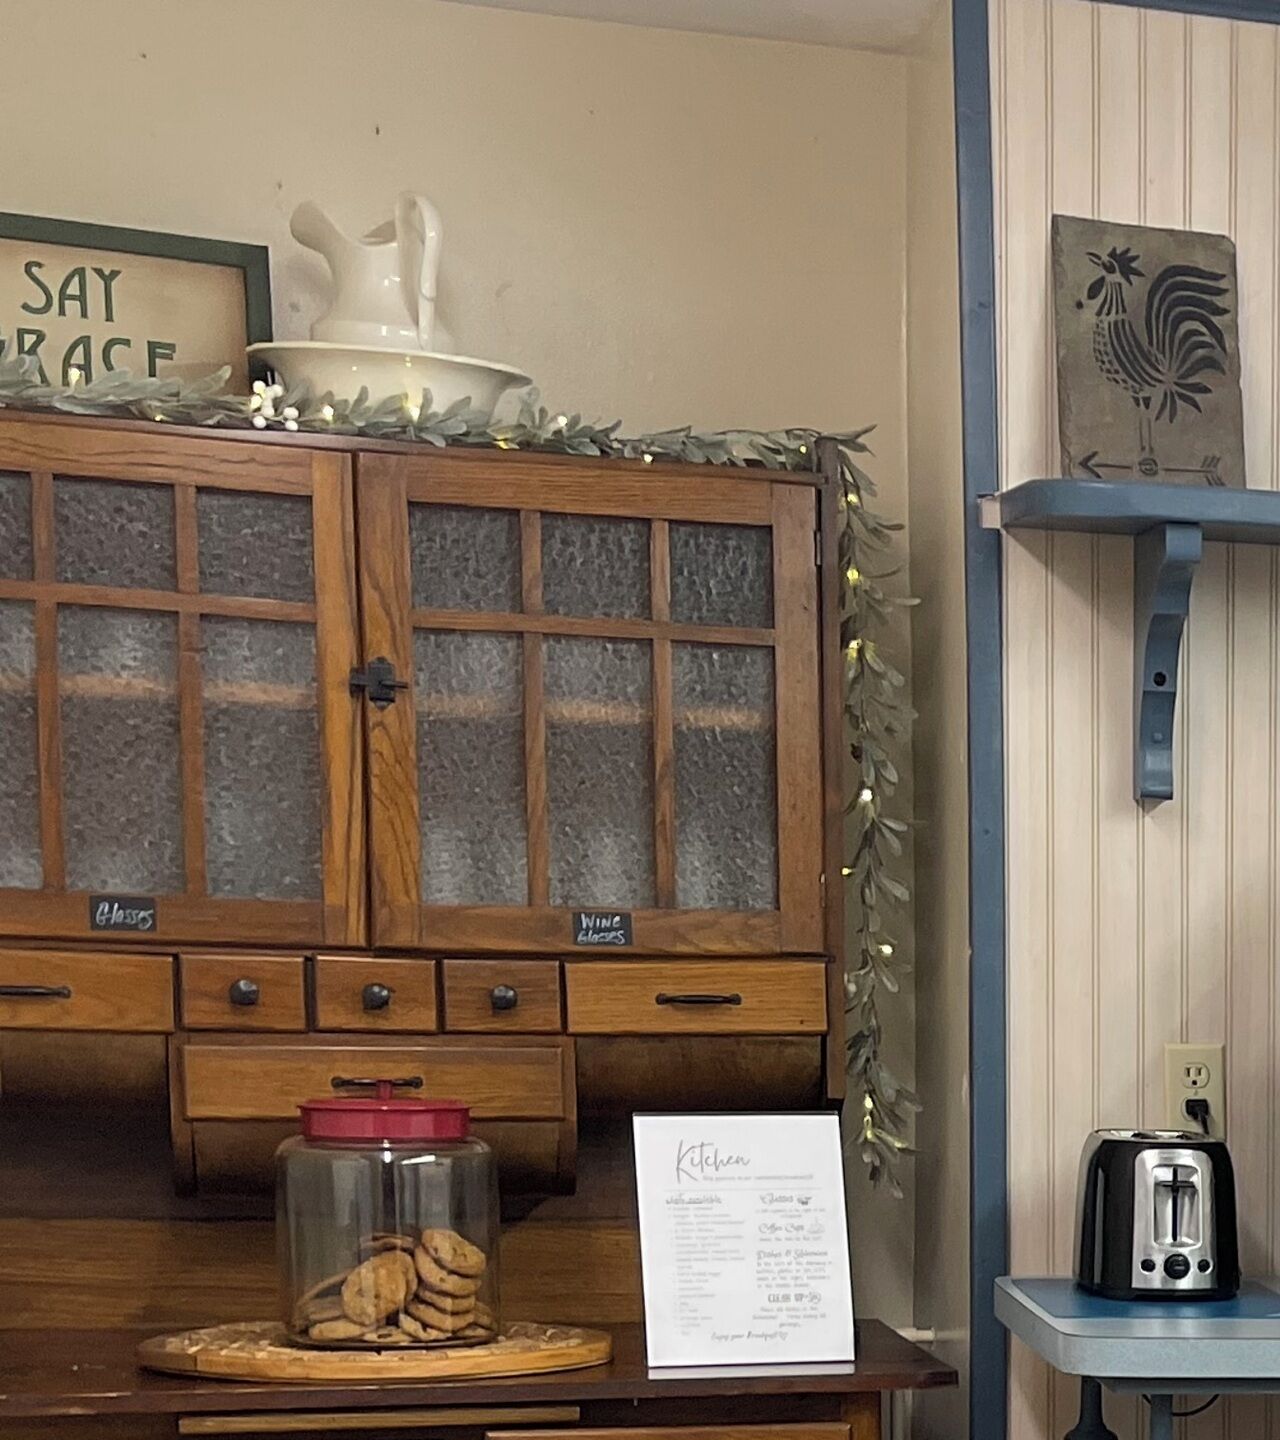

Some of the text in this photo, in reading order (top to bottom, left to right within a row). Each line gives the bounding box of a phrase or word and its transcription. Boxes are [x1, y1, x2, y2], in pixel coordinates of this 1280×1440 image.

[20, 260, 123, 323] SAY
[0, 326, 177, 387] RACE
[676, 1139, 751, 1184] Kitchen
